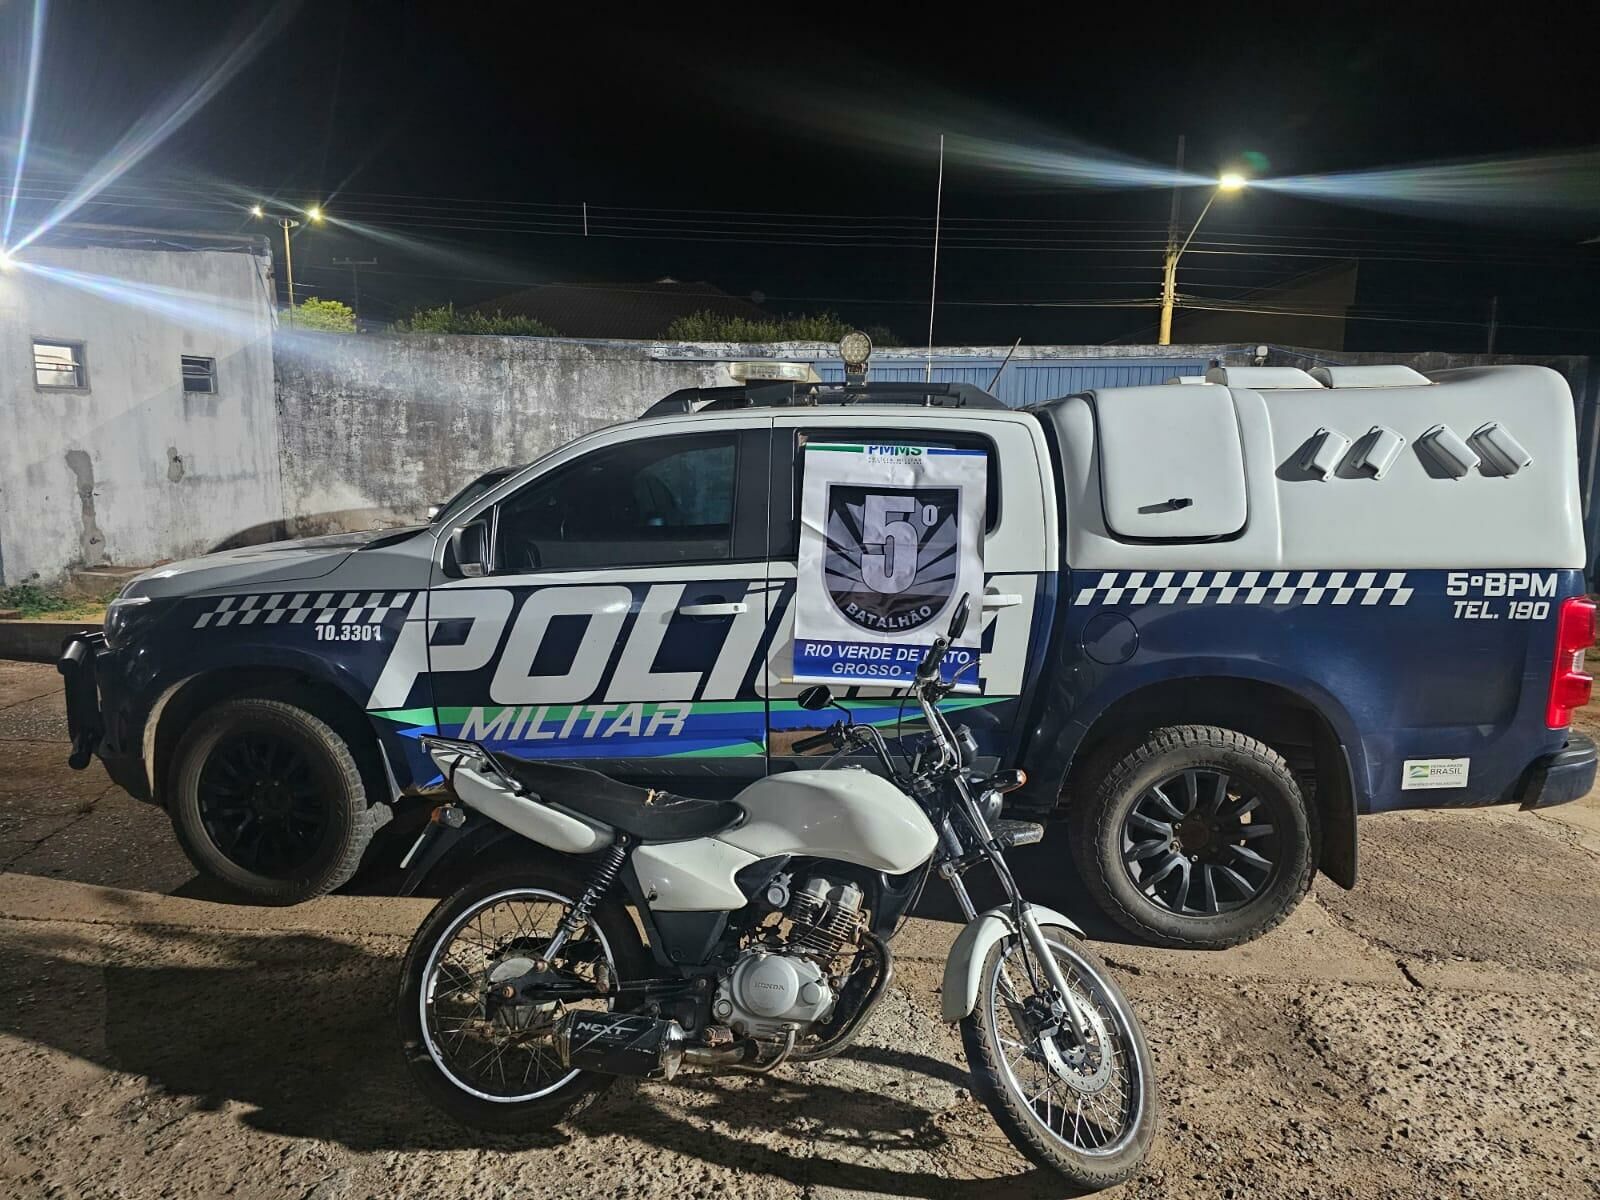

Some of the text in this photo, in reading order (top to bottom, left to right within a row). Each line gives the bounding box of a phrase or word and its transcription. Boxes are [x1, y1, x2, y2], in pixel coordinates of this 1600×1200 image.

[868, 446, 922, 456] PMMS
[845, 602, 932, 629] BATALHÃO
[1453, 600, 1551, 621] TEL. 190
[314, 624, 382, 642] 10.3301
[804, 643, 833, 658] RIO
[837, 645, 893, 661] VERDE
[896, 648, 920, 662] DE
[831, 662, 902, 677] GROSSO
[457, 702, 693, 743] MILITAR
[1430, 767, 1463, 776] BRASIL
[753, 981, 785, 991] HONDA
[576, 1021, 639, 1036] NEXT
